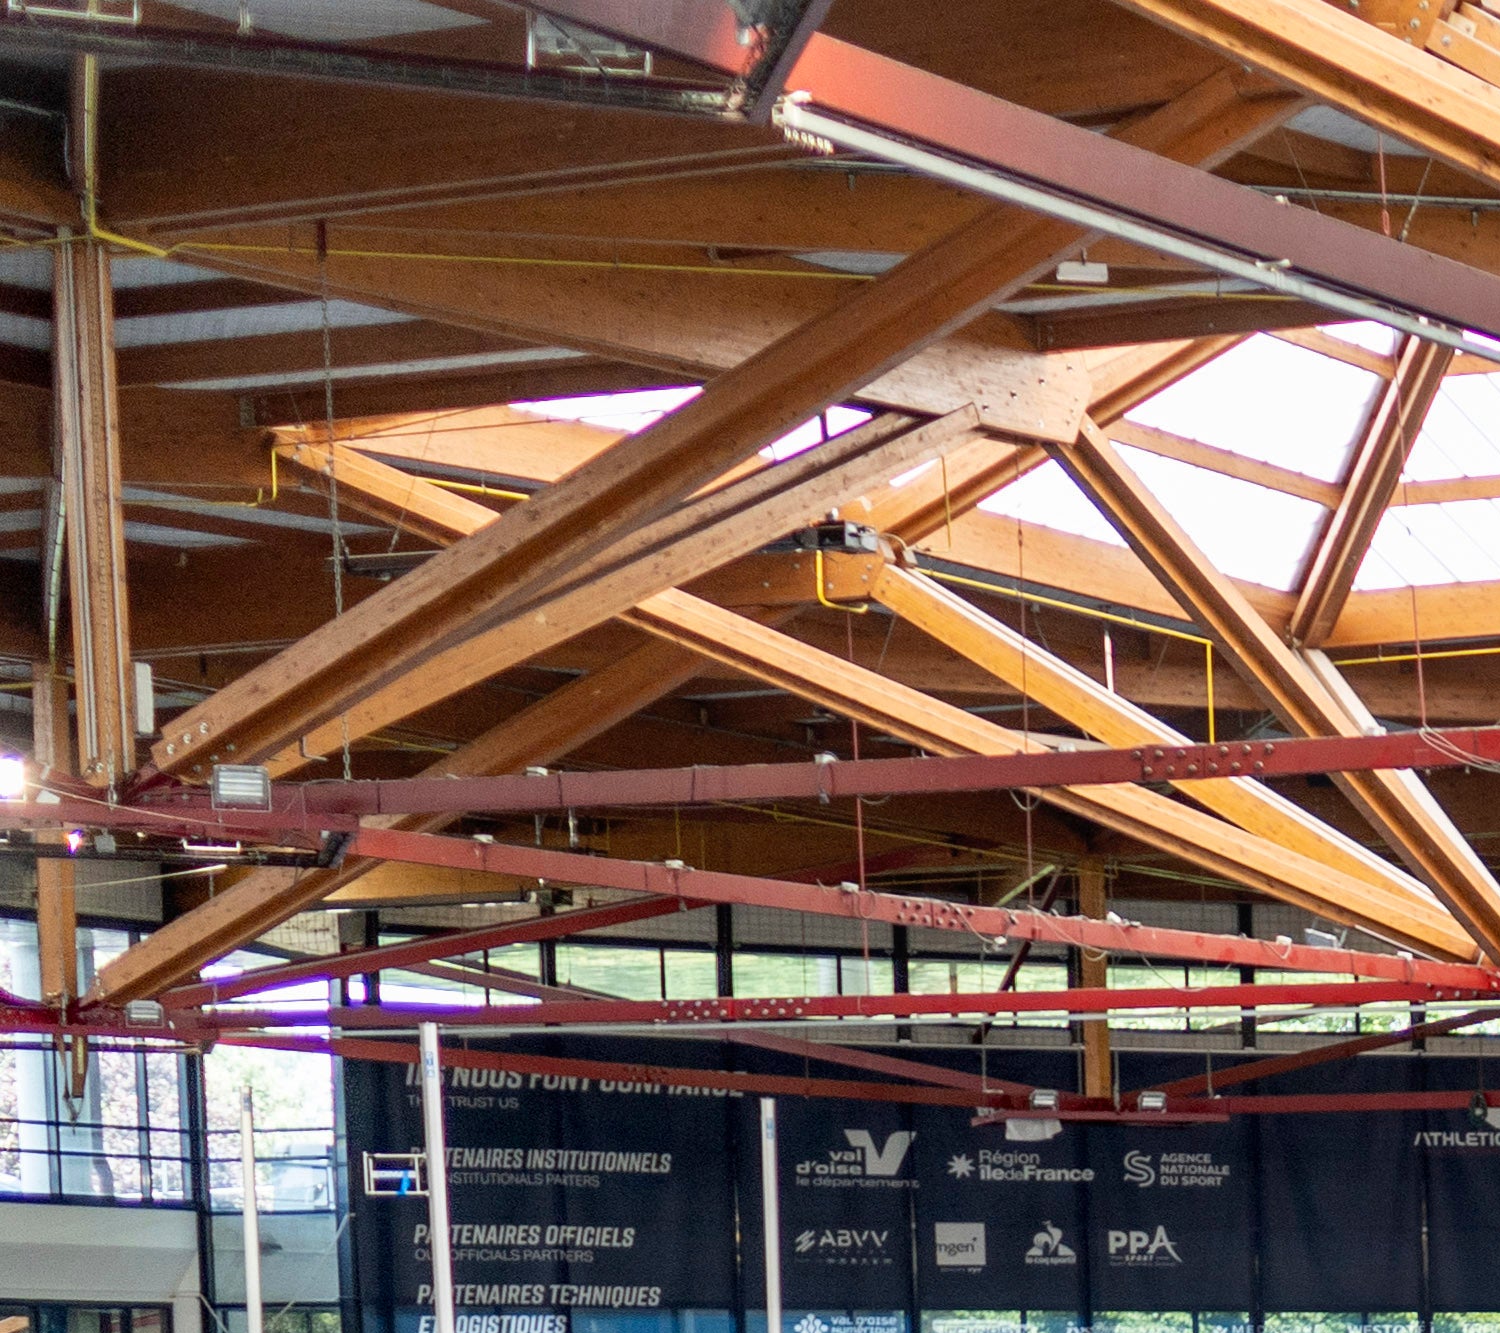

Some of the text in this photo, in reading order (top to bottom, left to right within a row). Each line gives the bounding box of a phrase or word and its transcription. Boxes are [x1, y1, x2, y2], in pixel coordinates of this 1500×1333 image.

[499, 1097, 519, 1109] US
[979, 1150, 1041, 1168] Région
[1160, 1153, 1212, 1164] AGENCE
[1160, 1164, 1230, 1176] NATIONALE
[1160, 1176, 1223, 1187] DU SPORT
[1108, 1225, 1182, 1262] PPA
